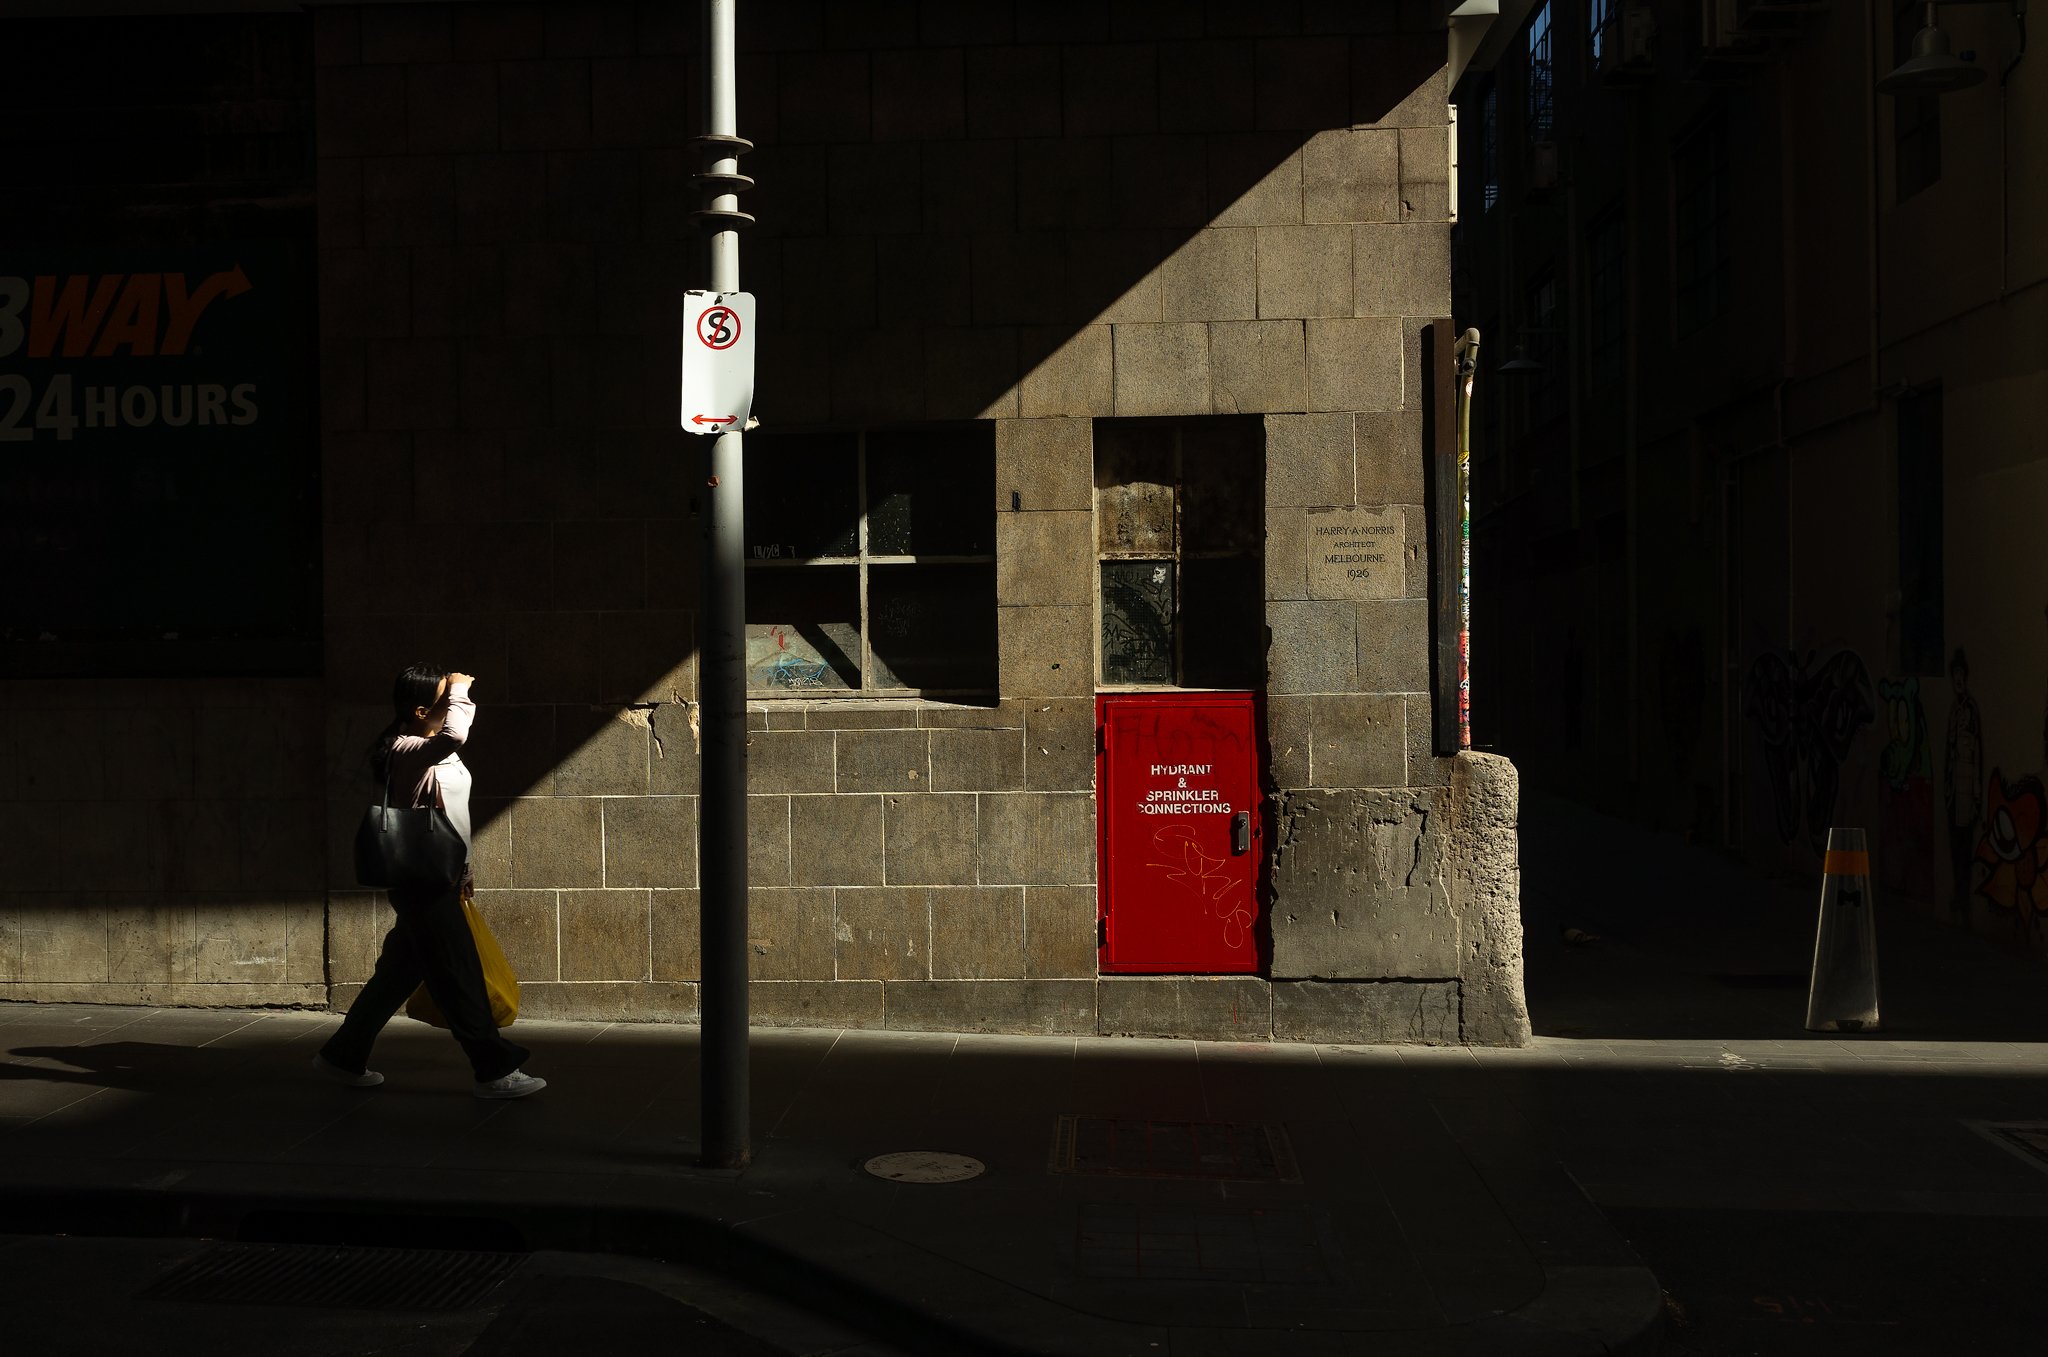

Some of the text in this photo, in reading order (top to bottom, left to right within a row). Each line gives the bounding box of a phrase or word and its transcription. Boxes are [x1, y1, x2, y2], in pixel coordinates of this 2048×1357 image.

[0, 373, 259, 443] 24 HOURS
[1325, 554, 1386, 563] MELBOURNE
[1347, 568, 1369, 581] 1926
[1151, 764, 1213, 775] HYDRANT
[1177, 777, 1187, 788] &
[1146, 790, 1219, 801] SPRINKLER
